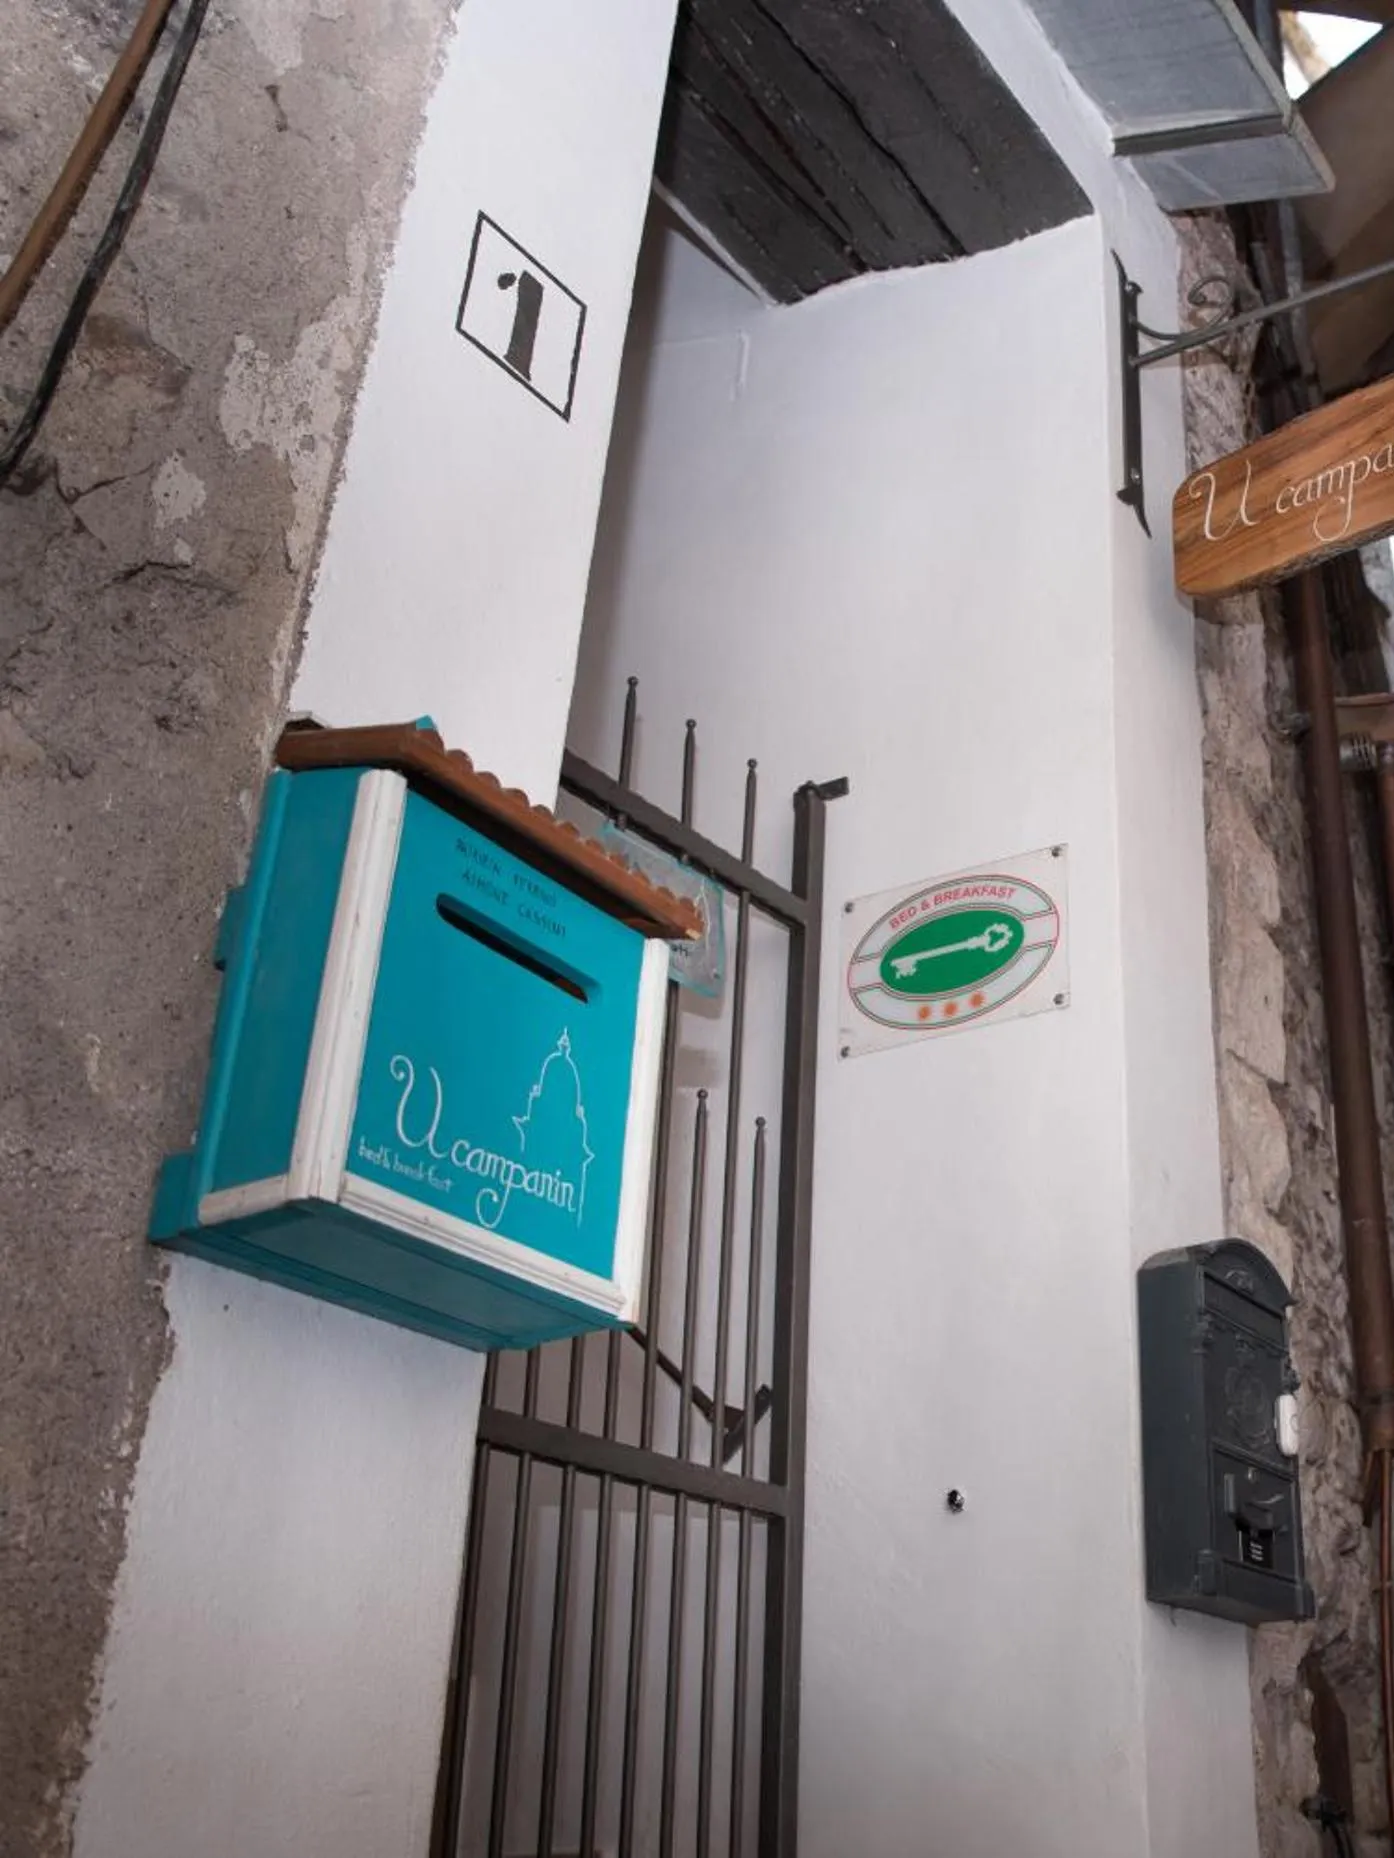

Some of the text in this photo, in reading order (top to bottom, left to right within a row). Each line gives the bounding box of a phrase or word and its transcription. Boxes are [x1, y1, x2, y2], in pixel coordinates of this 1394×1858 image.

[888, 884, 1018, 930] BED & BREAKFAST
[451, 1139, 577, 1230] campanin
